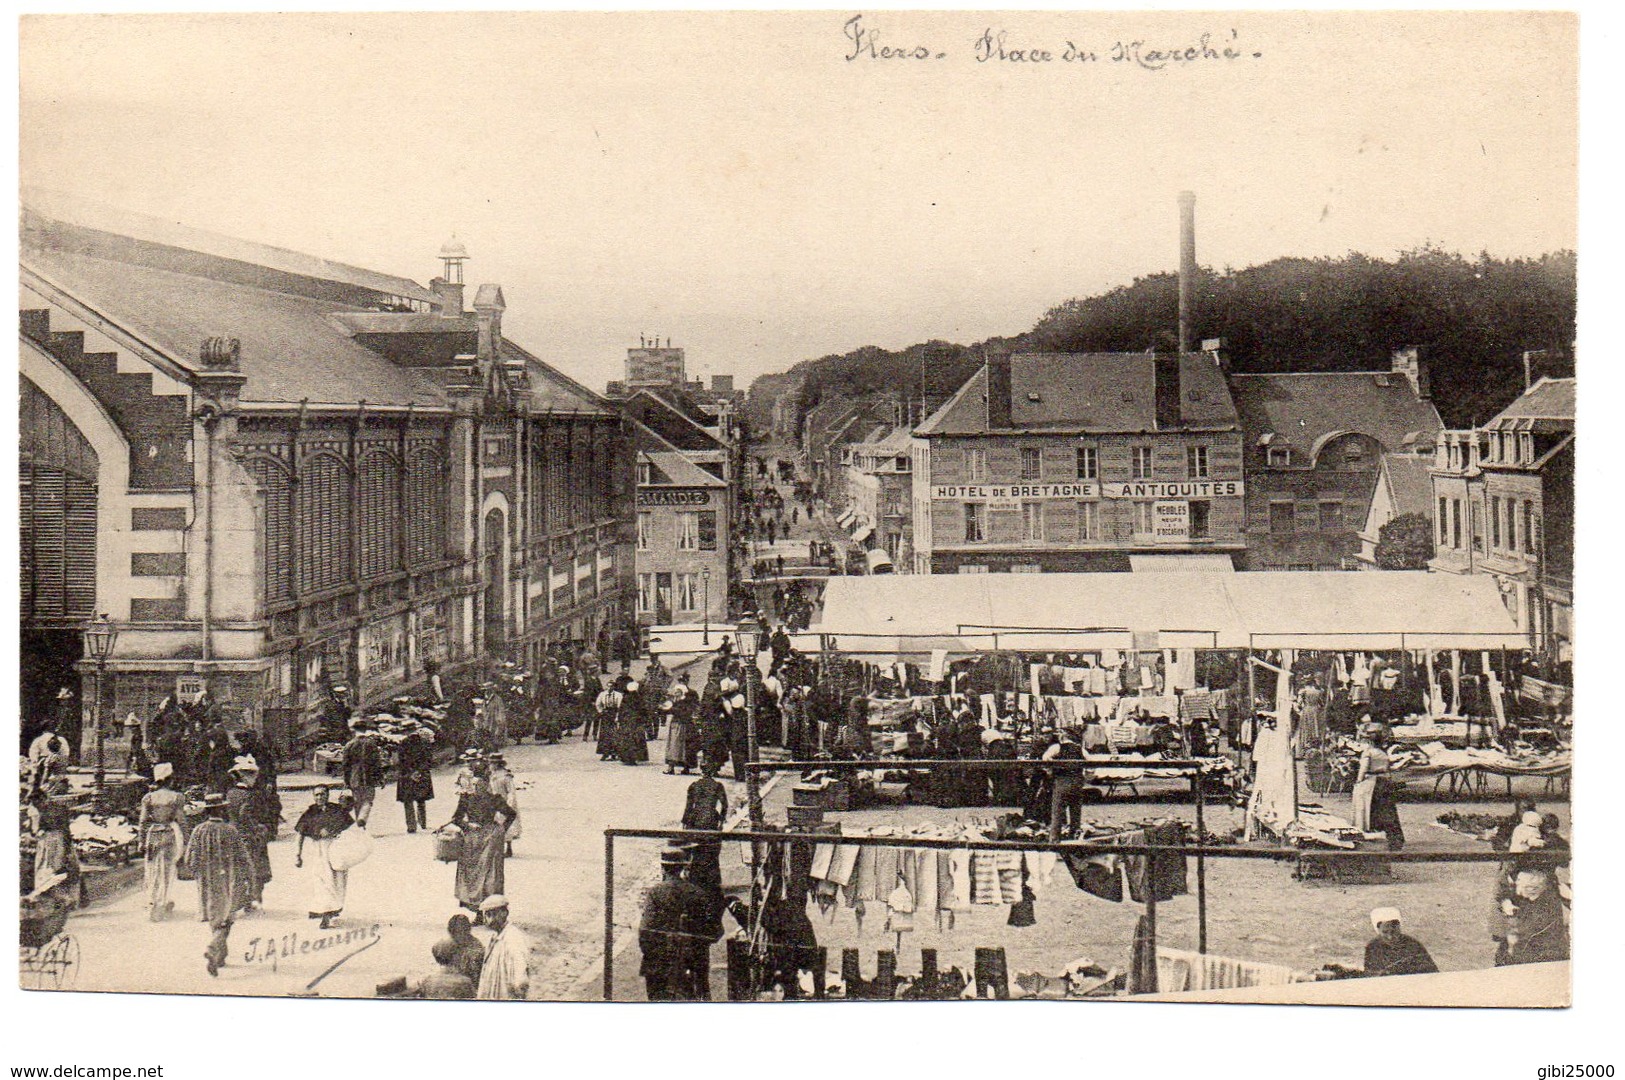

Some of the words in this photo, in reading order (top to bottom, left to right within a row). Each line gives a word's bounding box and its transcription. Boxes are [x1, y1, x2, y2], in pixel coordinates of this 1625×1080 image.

[974, 26, 1052, 63] Place
[1062, 40, 1097, 62] du
[938, 486, 988, 498] HOTEL
[992, 488, 1007, 498] DE
[1011, 485, 1092, 497] BRETAGNE
[1121, 480, 1236, 497] ANTIQUITÉS
[1156, 505, 1187, 516] MEUBLES
[180, 683, 201, 694] AVIS
